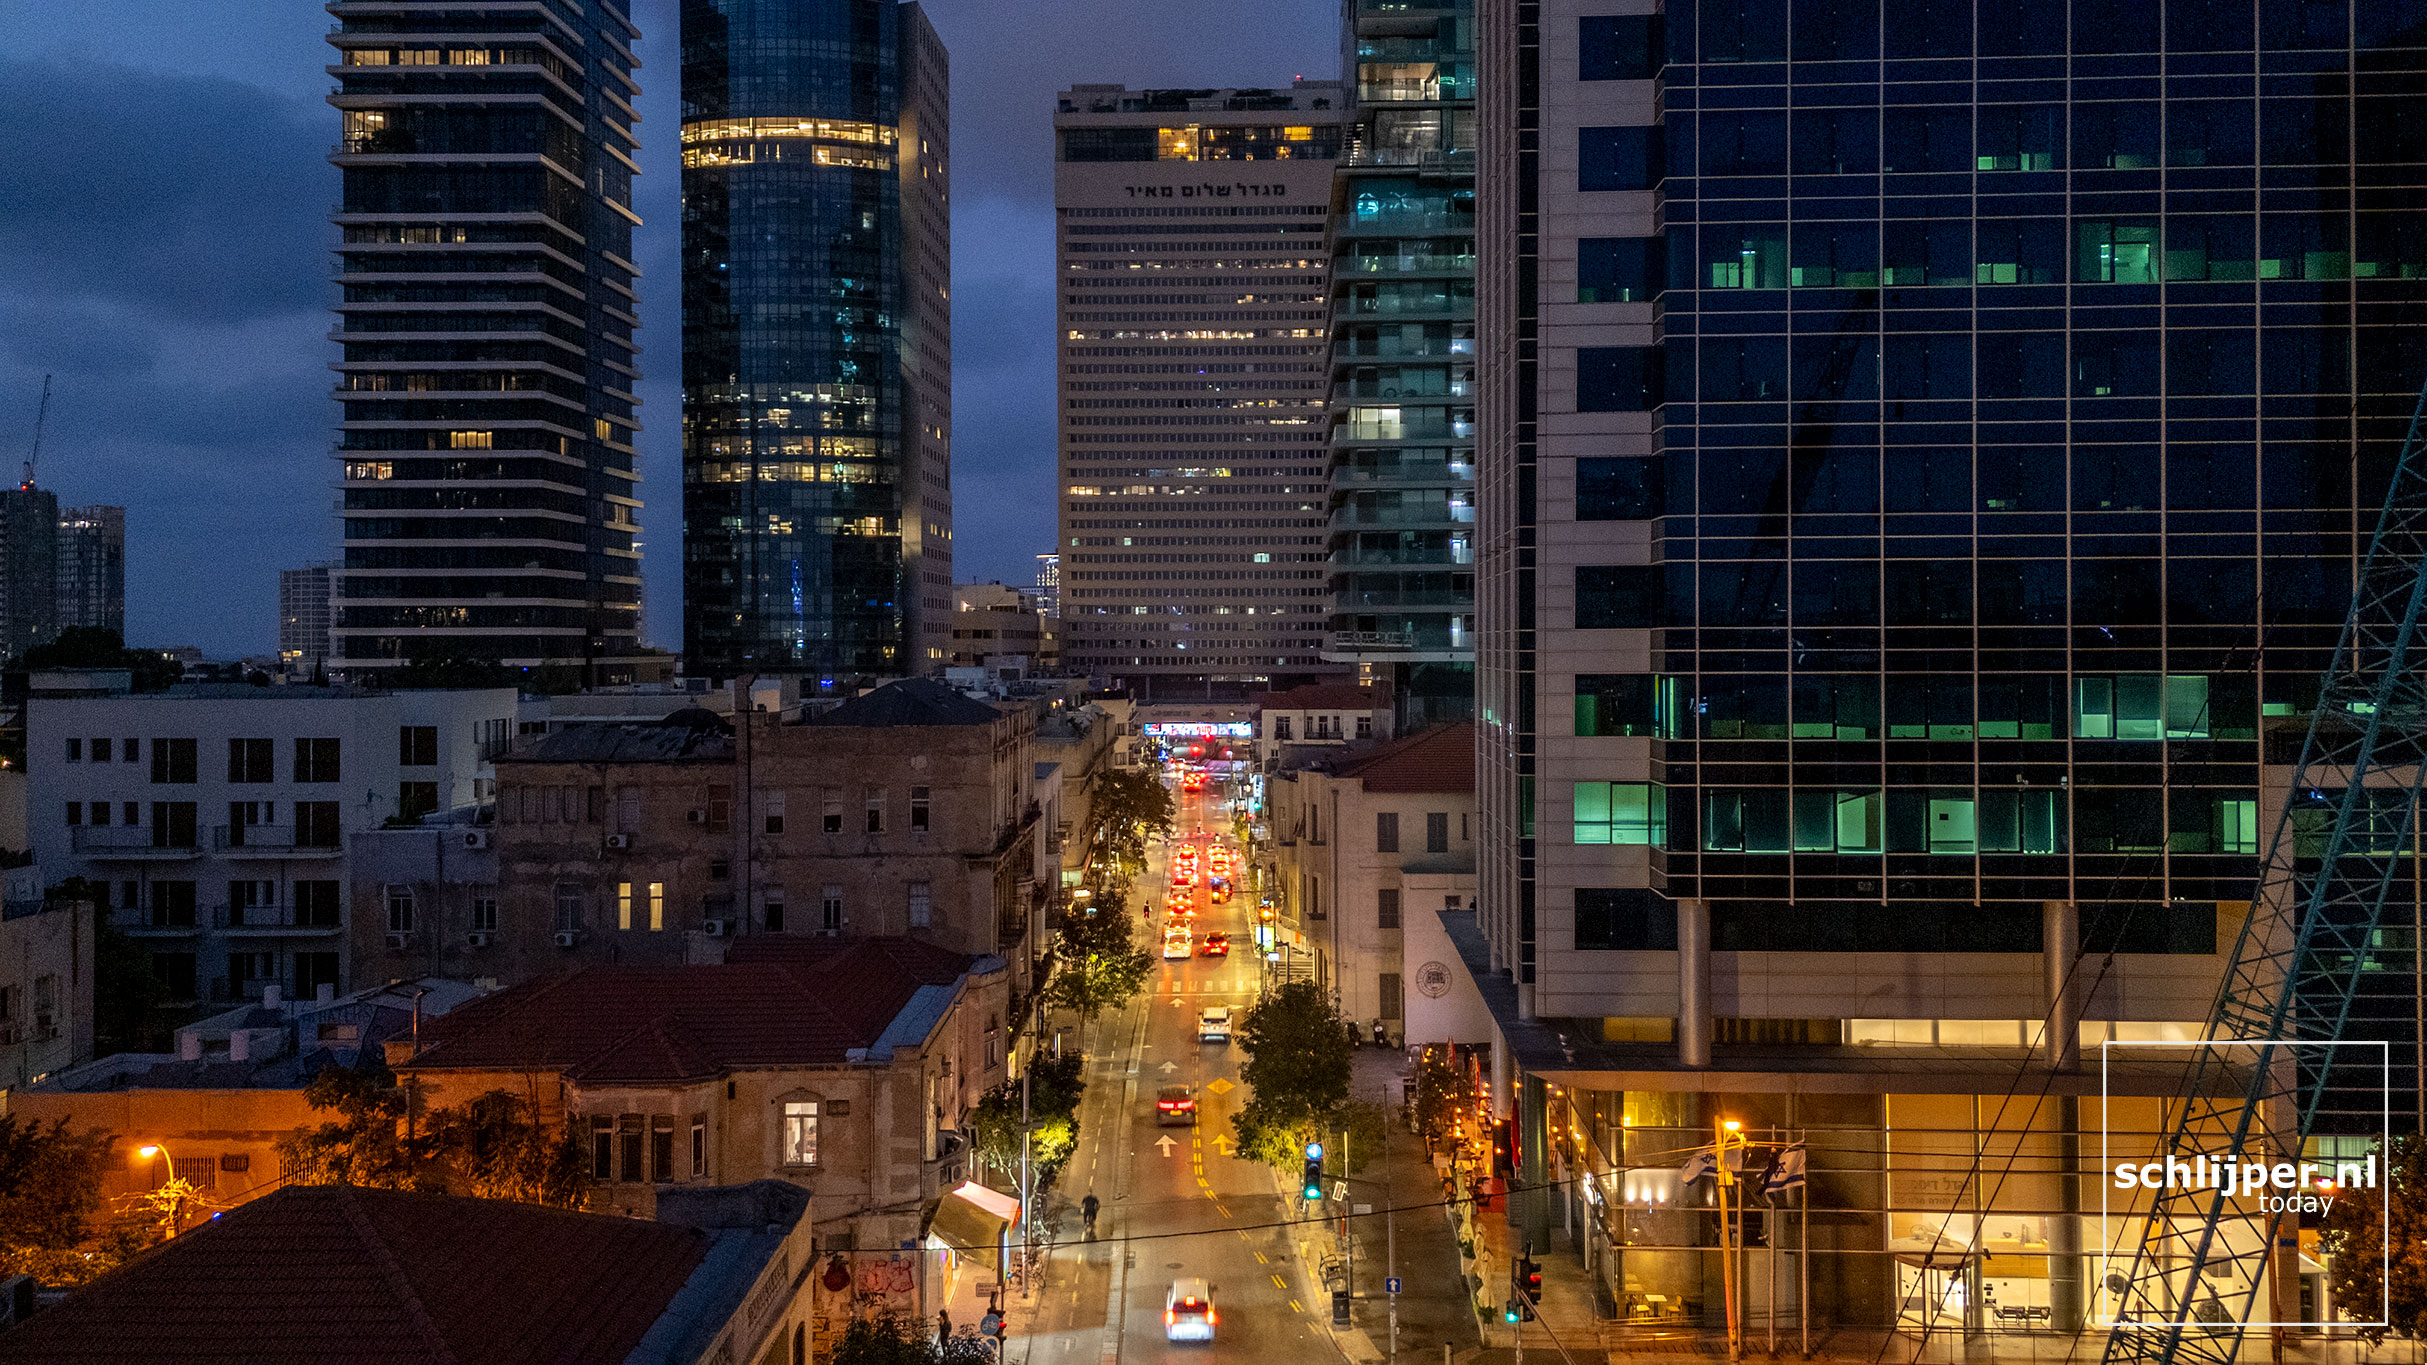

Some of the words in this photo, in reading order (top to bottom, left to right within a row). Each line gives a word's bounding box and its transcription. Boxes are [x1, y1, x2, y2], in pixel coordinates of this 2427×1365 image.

[1125, 185, 1173, 198] מאיר
[1181, 182, 1231, 197] שלום
[1236, 182, 1286, 197] מגדל
